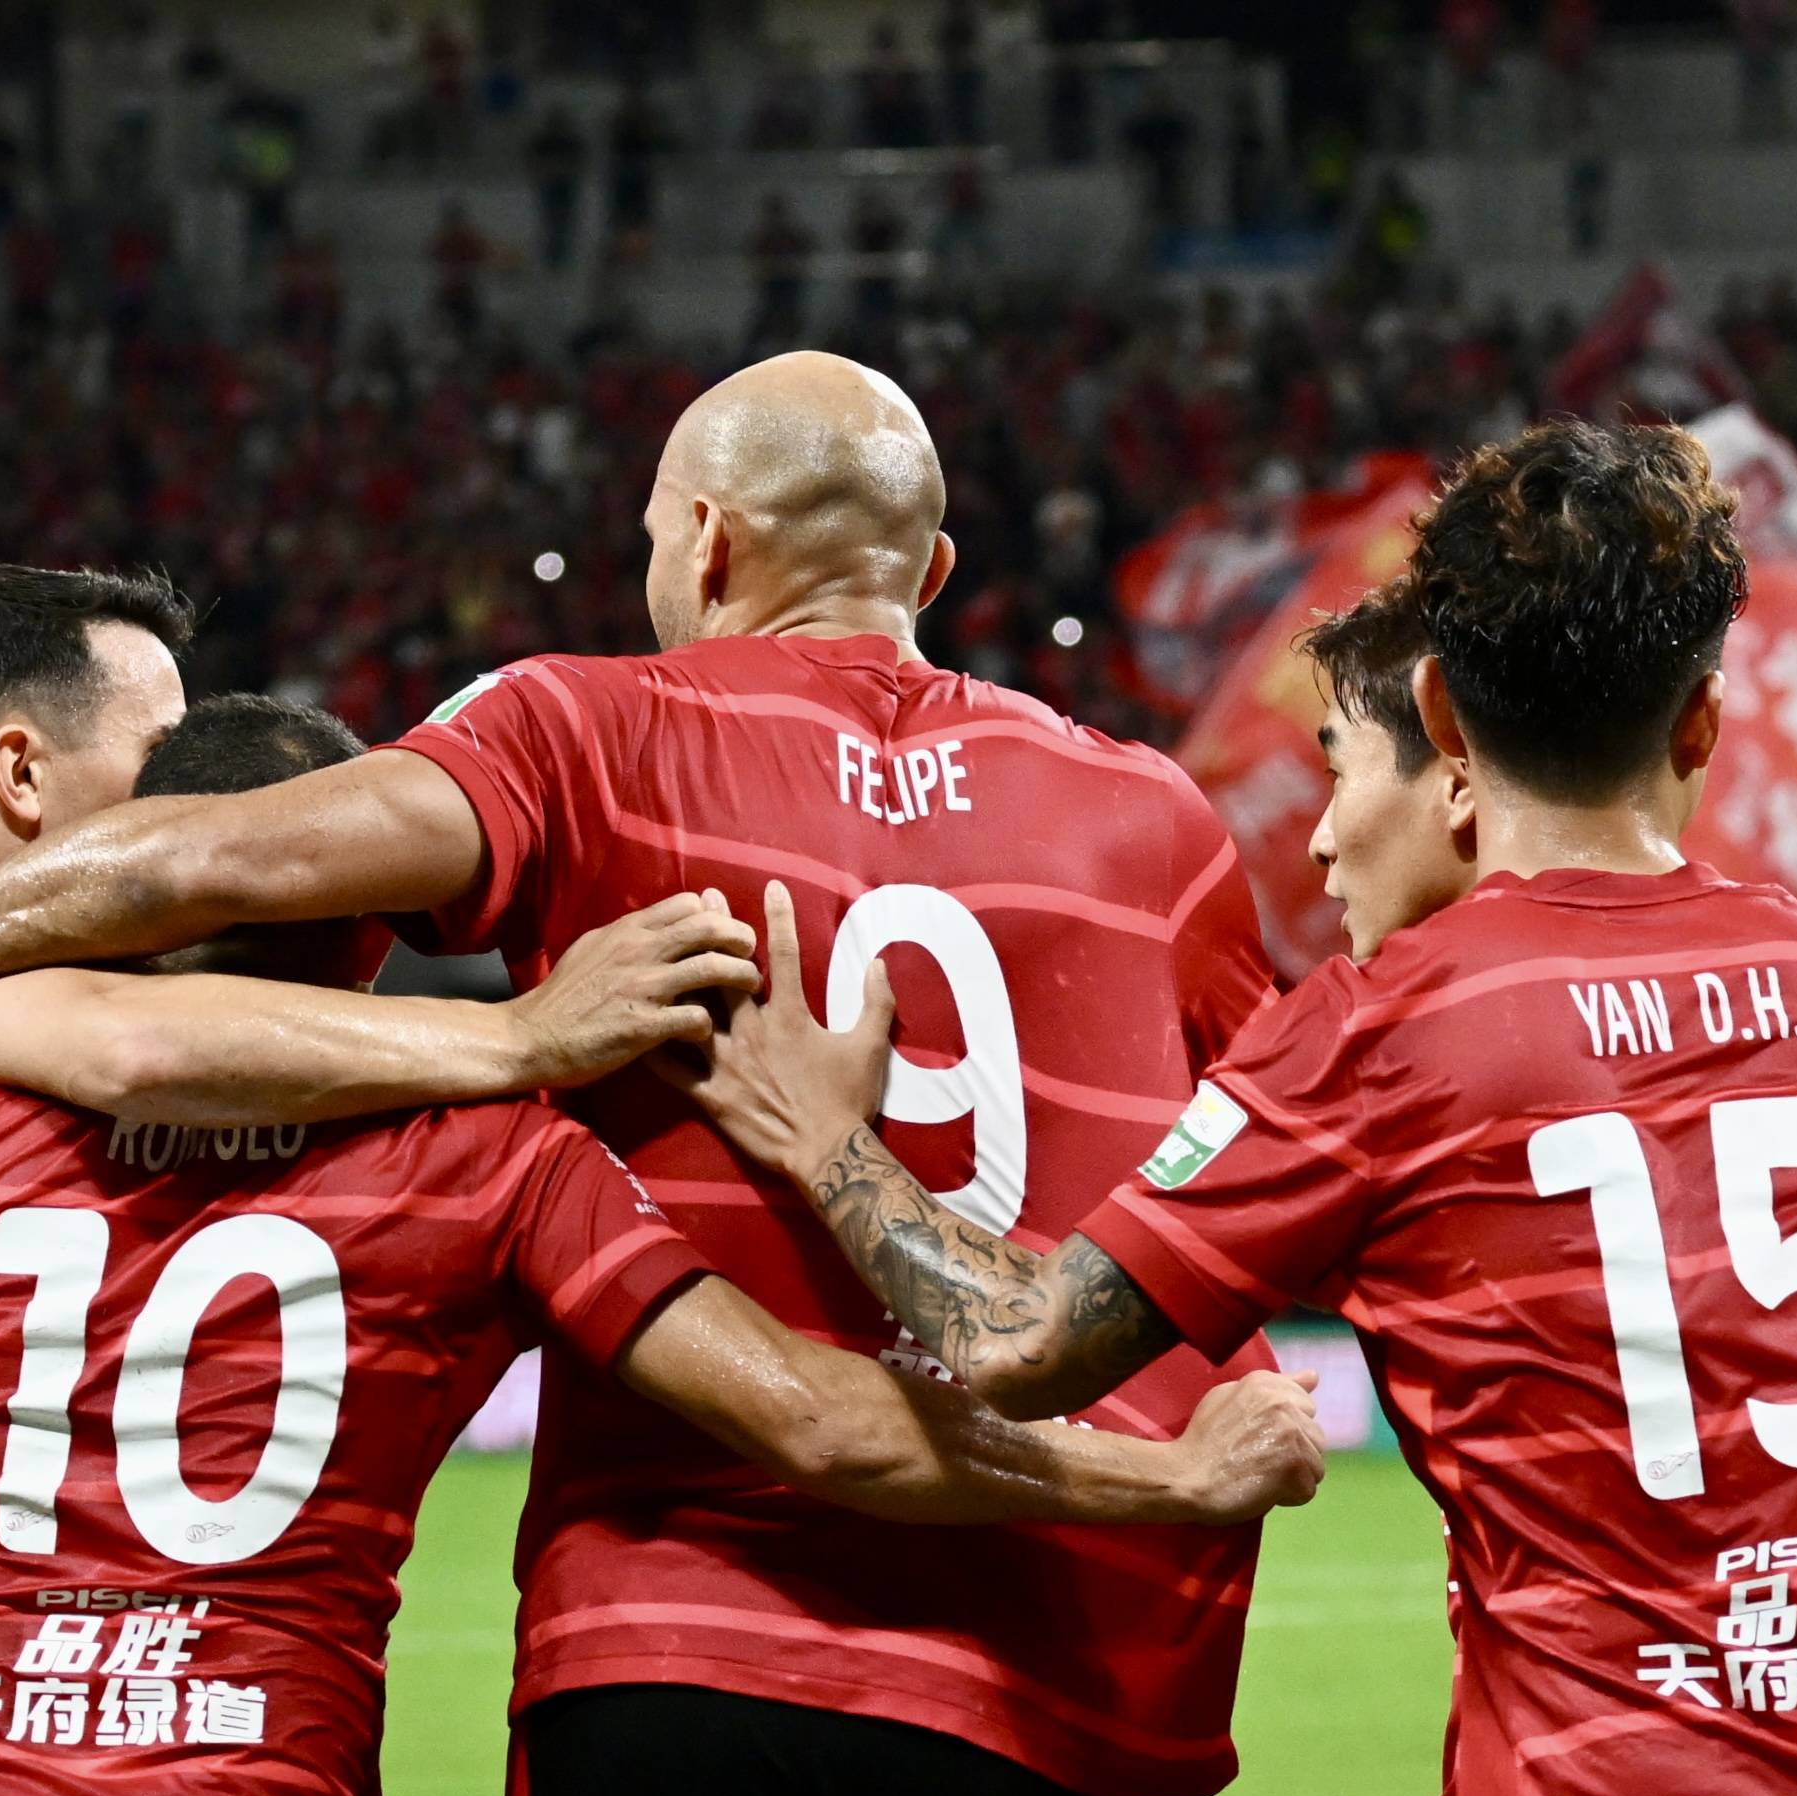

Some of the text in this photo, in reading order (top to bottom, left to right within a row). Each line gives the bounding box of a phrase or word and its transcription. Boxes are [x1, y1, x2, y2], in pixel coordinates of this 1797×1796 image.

[1568, 976, 1674, 1057] YAN
[826, 883, 1028, 1237] 9
[12, 1613, 202, 1678] 品胜
